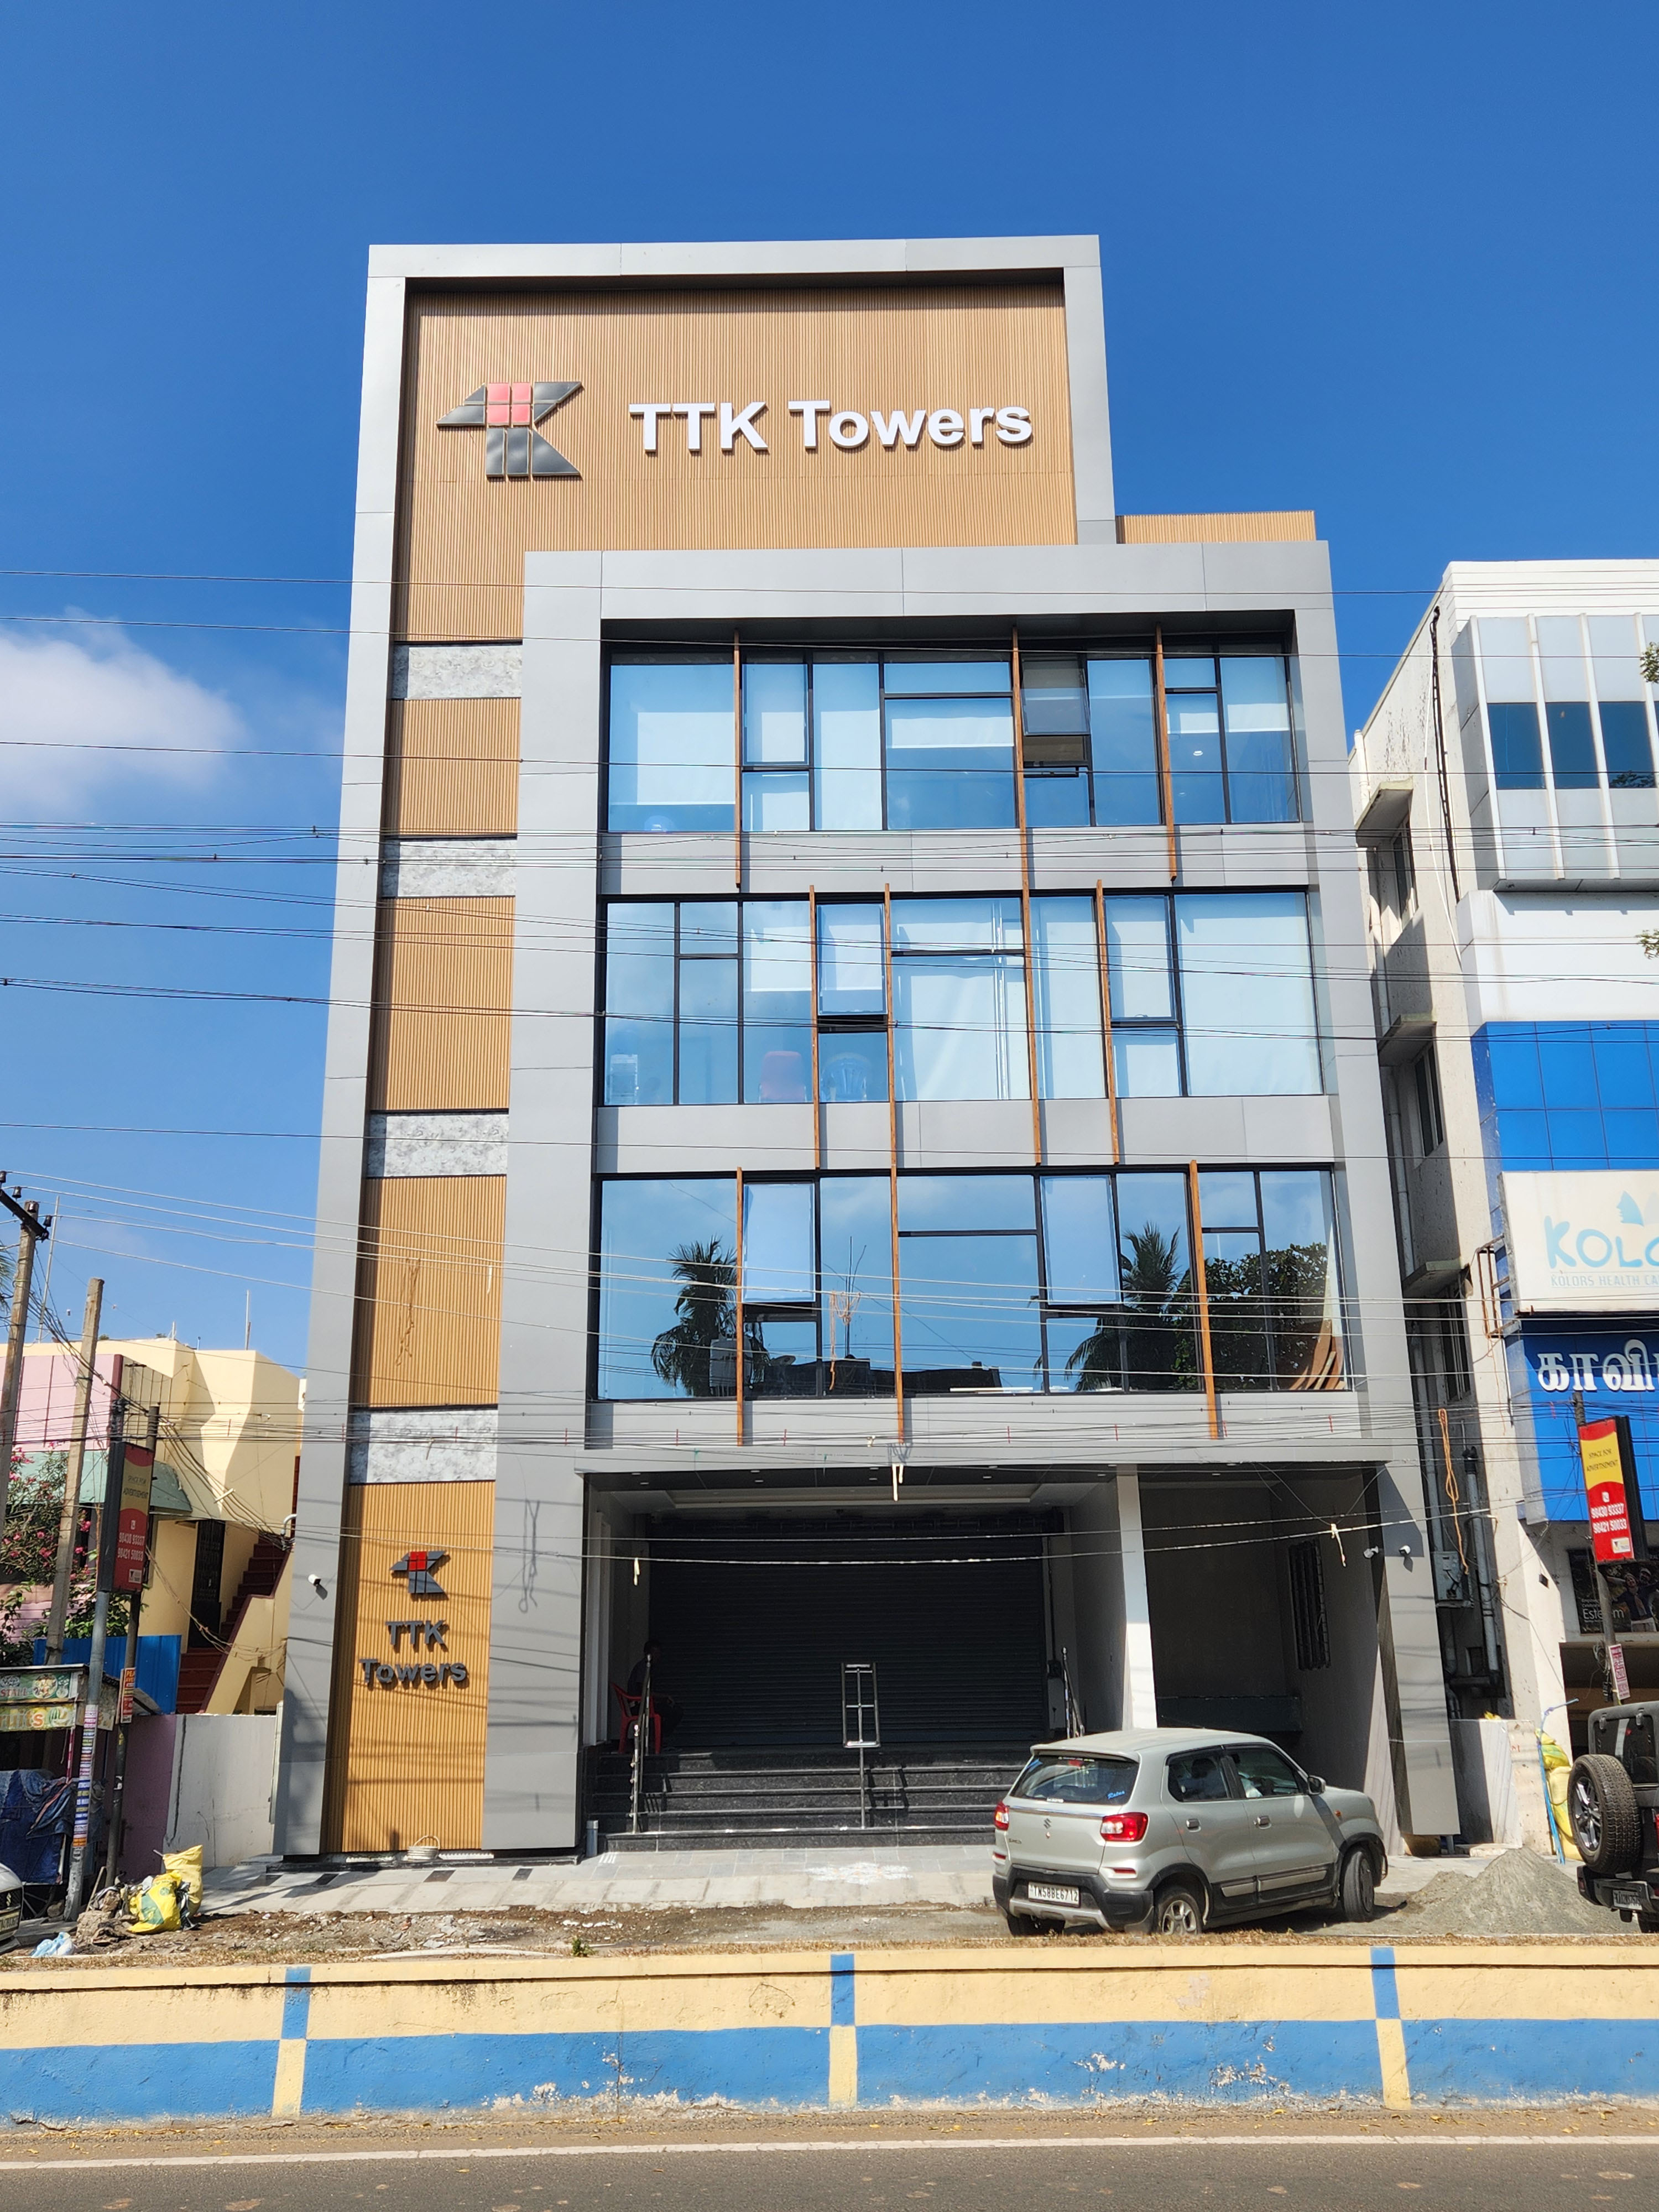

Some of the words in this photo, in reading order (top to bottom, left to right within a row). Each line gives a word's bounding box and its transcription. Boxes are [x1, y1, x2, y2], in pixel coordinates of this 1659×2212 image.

[629, 401, 769, 452] TTK
[788, 400, 1033, 450] Towers
[1551, 1274, 1594, 1287] KOLORS
[1599, 1274, 1640, 1286] HEALTH
[1537, 1339, 1659, 1391] காவி
[1582, 1608, 1624, 1620] Estem
[385, 1620, 446, 1646] TTK
[359, 1658, 467, 1683] Towers
[1034, 1885, 1078, 1902] TN58BE6712
